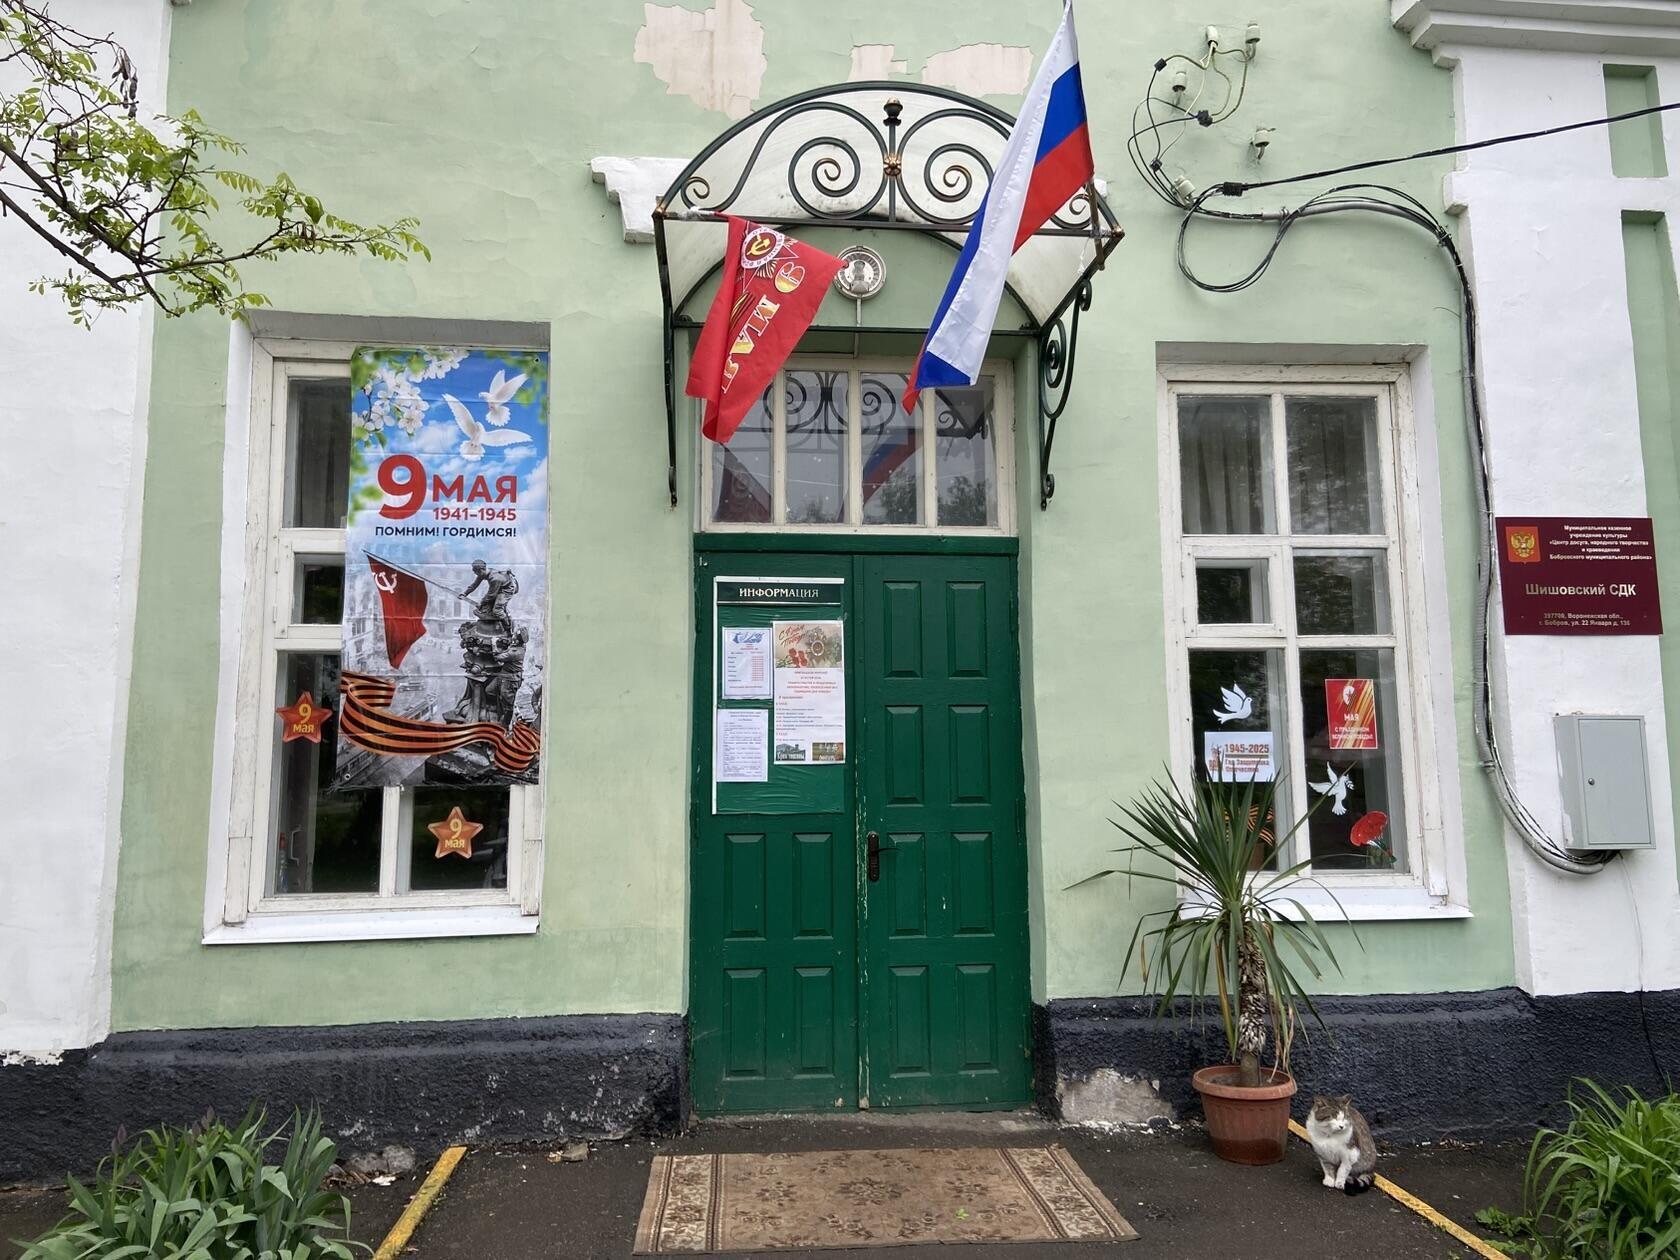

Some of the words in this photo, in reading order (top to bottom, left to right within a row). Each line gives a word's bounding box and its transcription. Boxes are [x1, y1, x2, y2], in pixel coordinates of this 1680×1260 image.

[774, 261, 806, 294] 9
[377, 454, 428, 520] 9
[432, 474, 518, 503] МАЯ
[375, 526, 440, 537] ПОМНИМ!
[443, 526, 517, 539] ГОРДИМСЯ!
[739, 588, 819, 598] ИНФОРМАЦИЯ
[1525, 583, 1606, 596] Шишовский
[1609, 584, 1637, 597] СДК
[299, 703, 312, 724] 9
[1344, 713, 1360, 721] МАЯ
[292, 723, 315, 733] мая
[1224, 743, 1270, 753] 1945-2025
[449, 818, 463, 840] 9
[444, 839, 465, 848] мая
